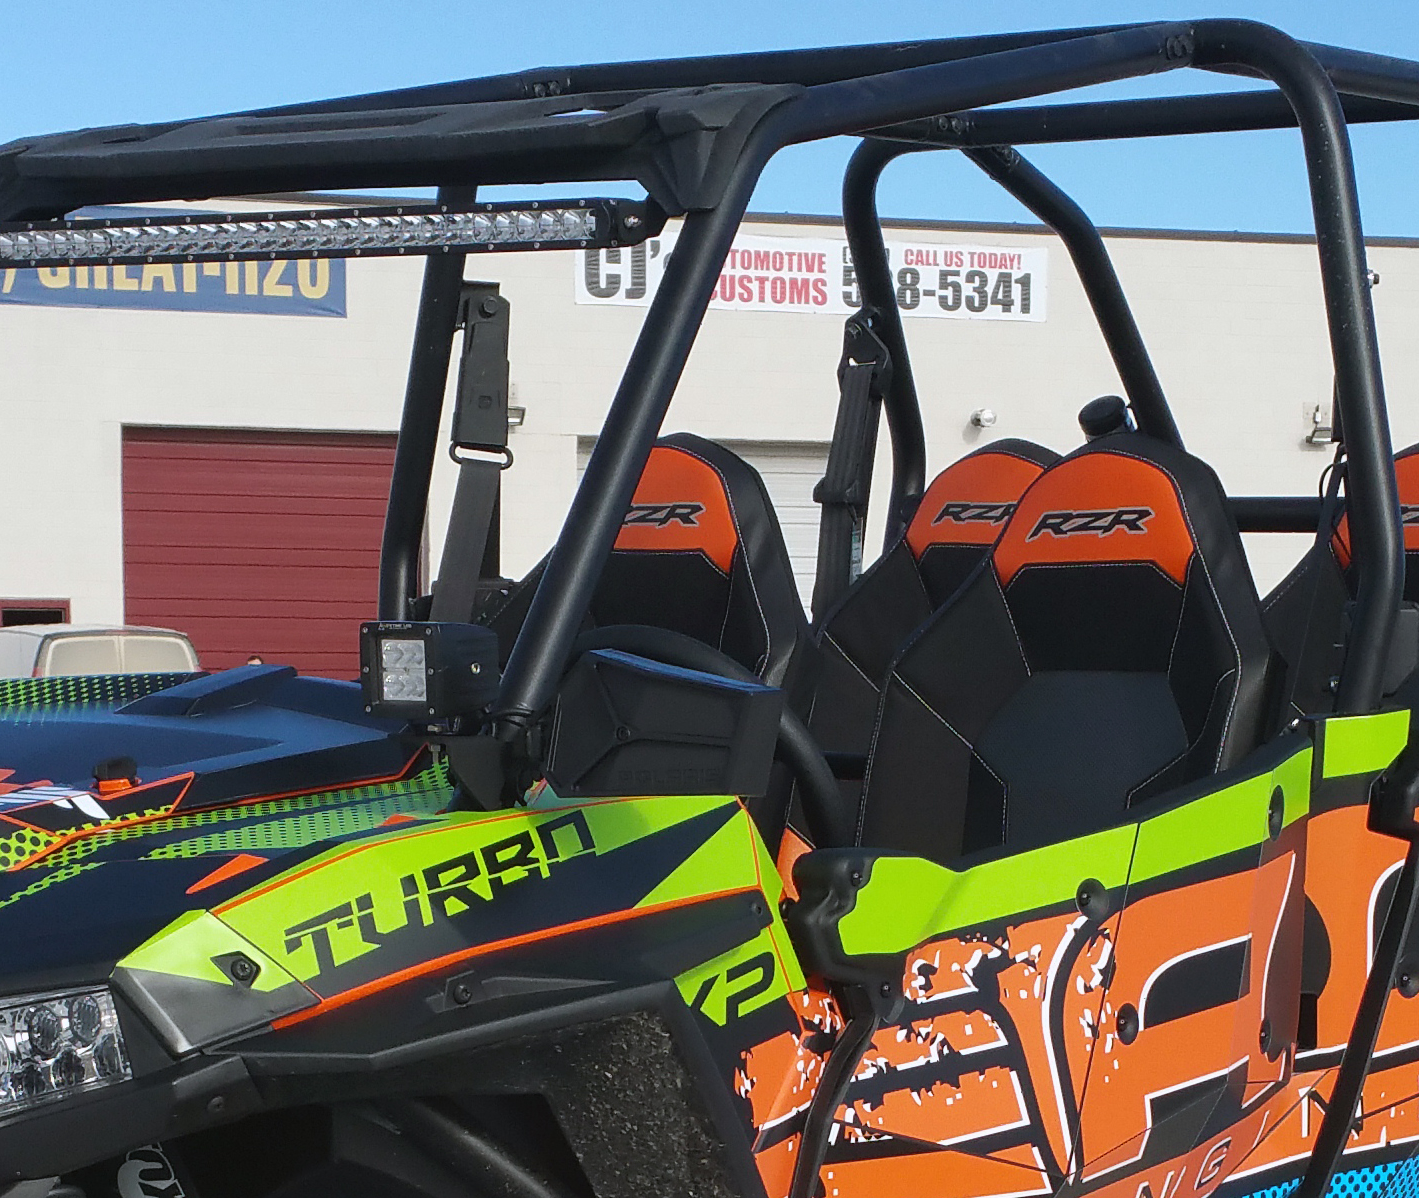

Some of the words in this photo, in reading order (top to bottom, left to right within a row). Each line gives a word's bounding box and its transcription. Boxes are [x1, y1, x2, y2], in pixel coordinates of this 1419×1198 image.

[723, 249, 827, 274] TOMOTIVE
[904, 249, 939, 266] CALL
[944, 250, 963, 268] US
[968, 252, 1021, 270] TODAY!
[711, 274, 828, 306] USTOMS
[842, 266, 1031, 314] 58-5341
[1027, 508, 1156, 542] RZR
[283, 809, 597, 976] TURBO
